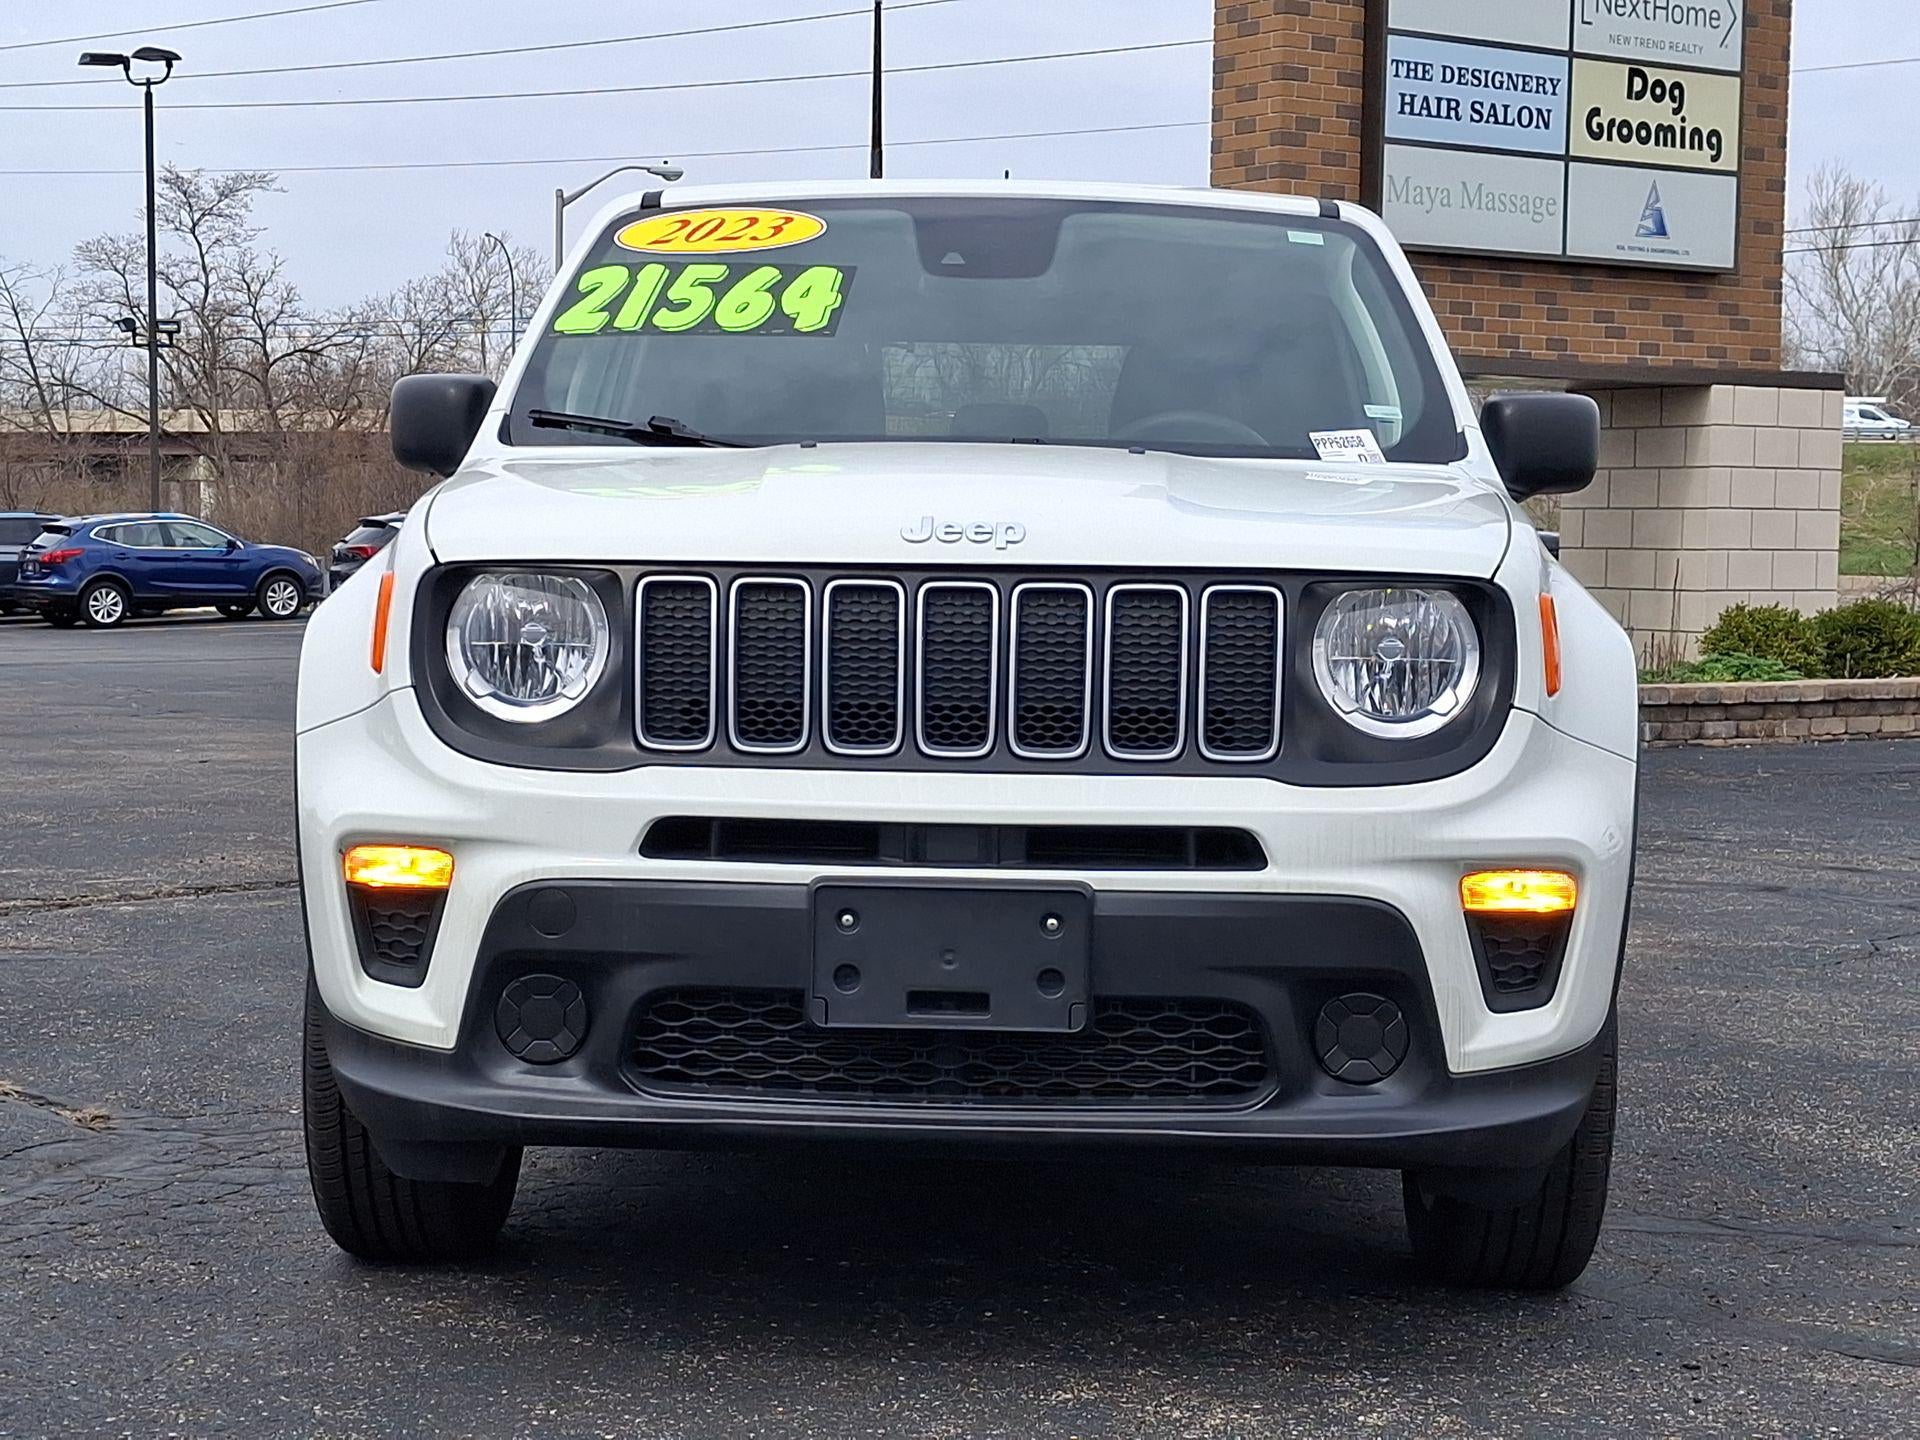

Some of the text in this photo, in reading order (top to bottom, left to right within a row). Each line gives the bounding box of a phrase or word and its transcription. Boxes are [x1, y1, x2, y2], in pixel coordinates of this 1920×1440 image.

[1595, 0, 1721, 29] NextHome
[1608, 34, 1704, 55] NEW TREND REALTY
[1391, 58, 1562, 97] THE DESIGNERY
[1626, 66, 1685, 116] Dog
[1397, 92, 1553, 130] HAIR SALON
[1585, 106, 1723, 163] Grooming
[1387, 174, 1557, 223] Maya Massage
[646, 216, 795, 246] 2023
[553, 262, 845, 334] 21564
[900, 516, 1026, 550] Jeep
